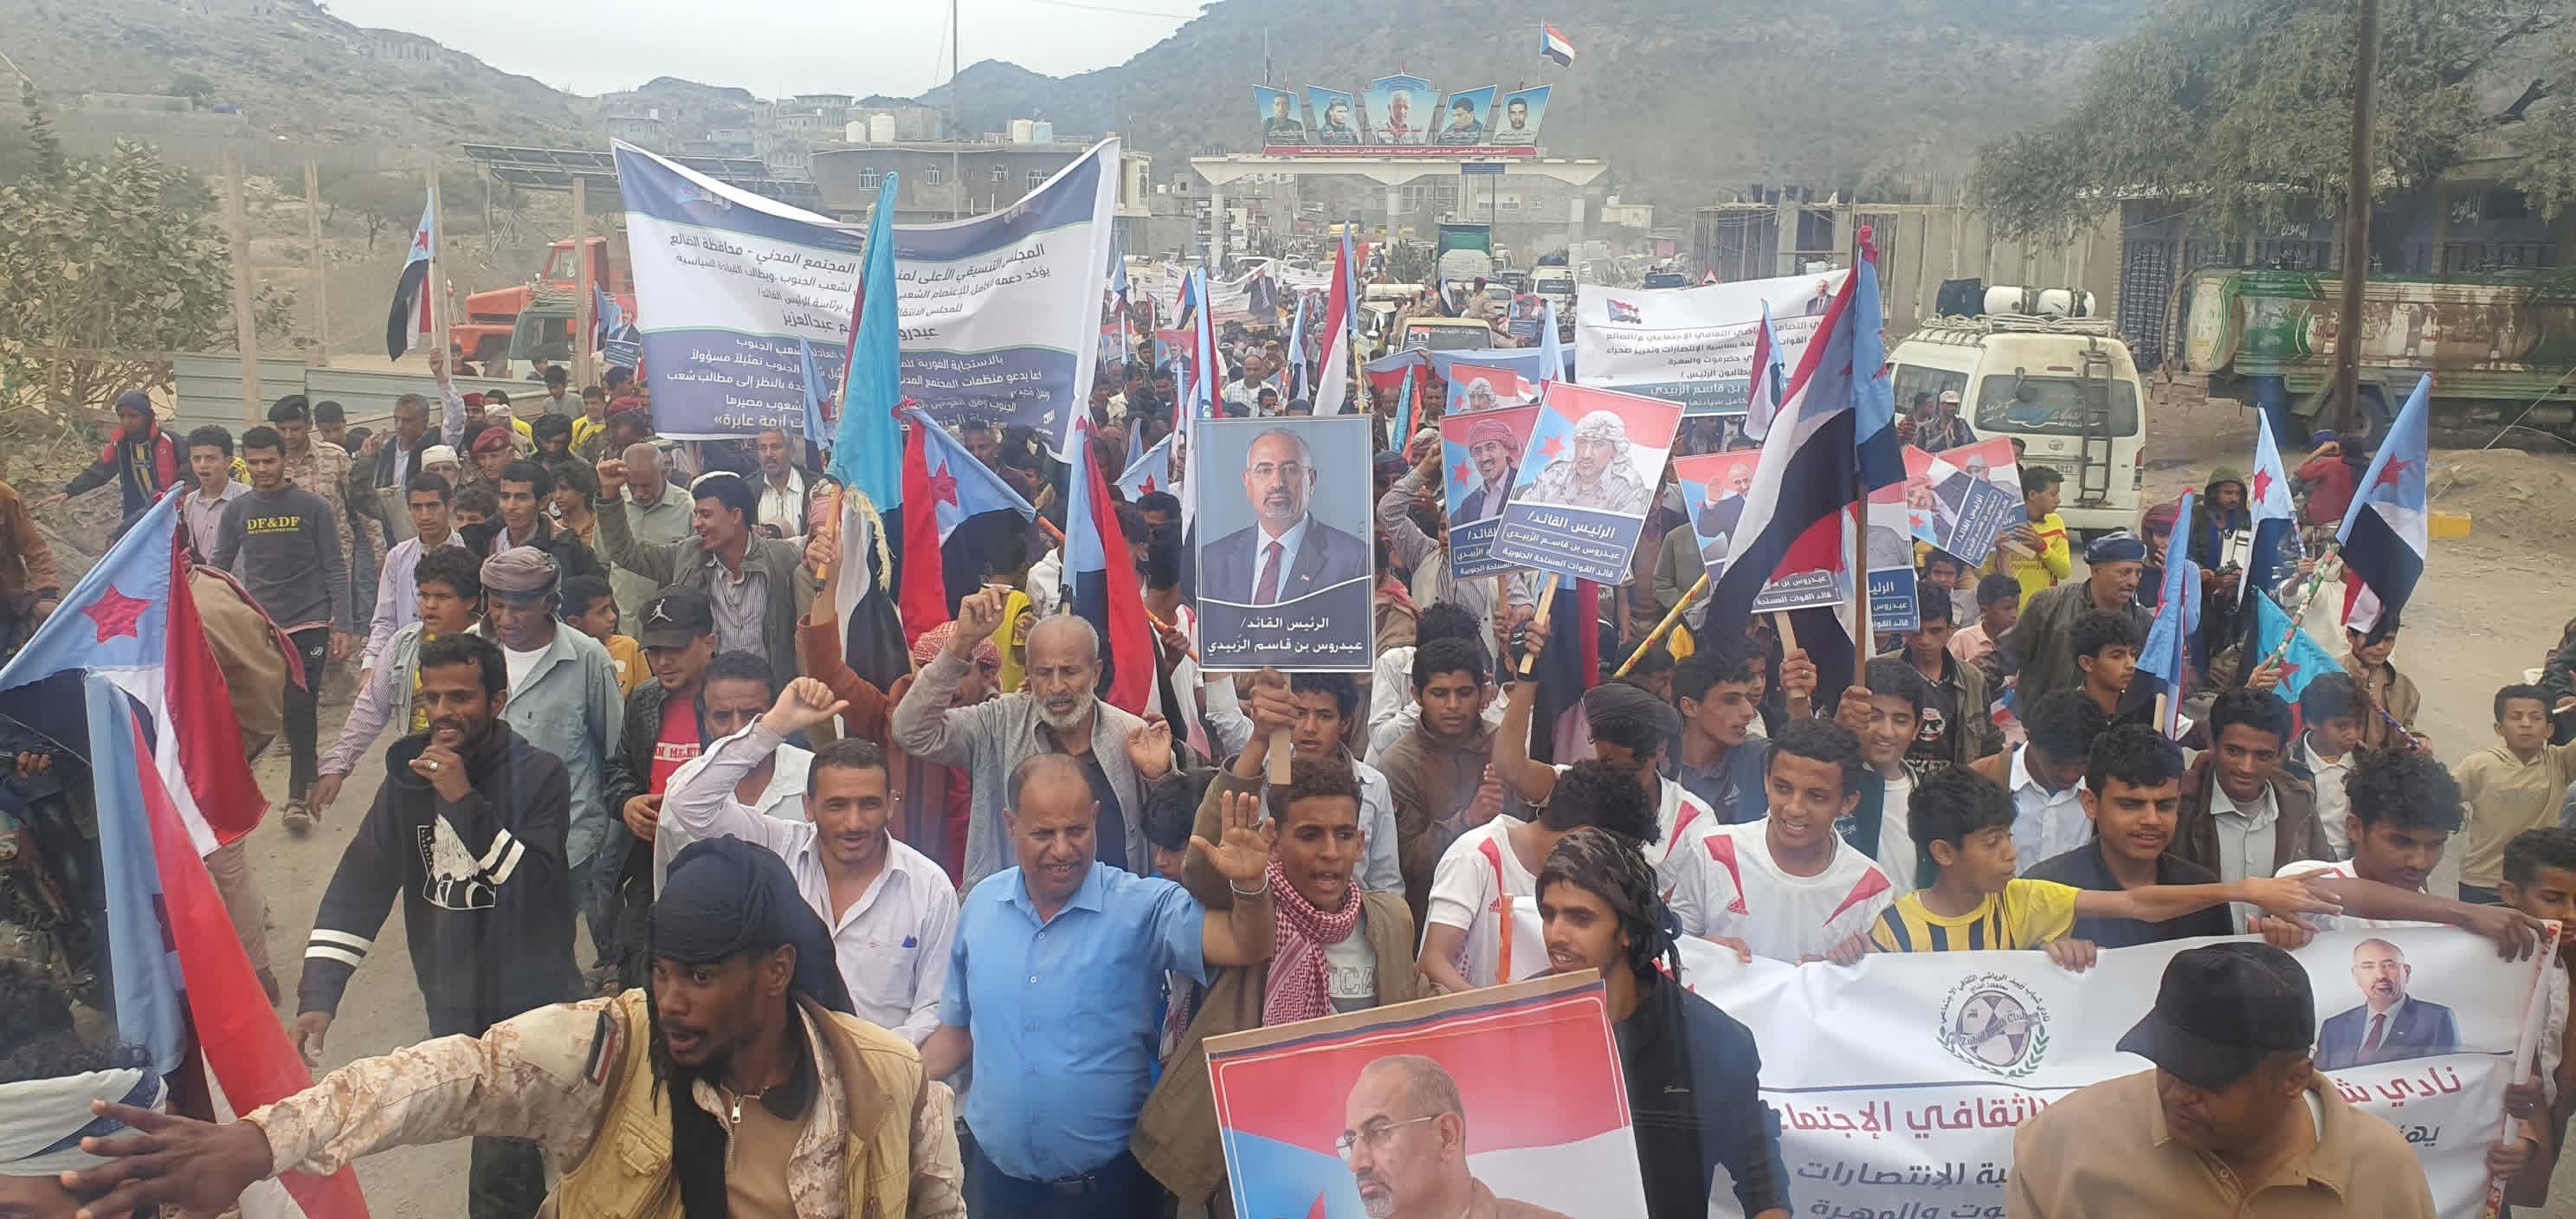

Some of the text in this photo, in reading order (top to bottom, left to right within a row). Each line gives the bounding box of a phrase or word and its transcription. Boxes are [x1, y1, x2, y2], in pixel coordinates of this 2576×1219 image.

[670, 232, 700, 248] الضالع
[702, 238, 743, 256] محافظة
[755, 248, 802, 265] المدني
[1003, 243, 1045, 268] المجلس
[717, 262, 743, 275] القيادة
[803, 257, 856, 275] المجتمع
[956, 257, 1003, 282] التنسيقي
[1025, 266, 1050, 280] يؤكد
[780, 276, 817, 288] الجنوب
[996, 274, 1023, 287] دعمه
[817, 281, 854, 294] لشعب
[784, 295, 812, 306] الرئيس
[898, 304, 926, 317] الانتقا
[926, 303, 964, 316] للمجلس
[782, 310, 835, 331] عبدالعزيز
[899, 326, 940, 341] عيدرو
[736, 338, 773, 352] الجنوب
[775, 345, 804, 356] شعب
[765, 359, 800, 374] الجنوب
[917, 358, 950, 371] الفورية
[667, 368, 695, 381] شعب
[698, 372, 733, 384] مطالب
[1006, 372, 1030, 384] يدعو
[1030, 370, 1043, 382] كما
[1687, 369, 1716, 379] الرئيس
[736, 375, 753, 389] إلى
[755, 375, 785, 390] بالنظر
[925, 377, 959, 389] المجتمع
[962, 374, 1004, 388] منظمات
[1692, 383, 1726, 395] قاسم
[726, 394, 763, 408] مصيرها
[765, 400, 804, 412] شعوب
[248, 516, 300, 530] DF&DF
[1468, 527, 1497, 540] لقائد/
[1570, 521, 1616, 539] الرئيس
[1540, 537, 1569, 550] قاسم
[1570, 542, 1581, 553] بن
[1582, 545, 1621, 560] عيدروس
[1502, 546, 1615, 578] قائد القوات المسلحة الجنوبية
[1792, 575, 1828, 586] عيدروس
[1869, 581, 1895, 596] الرئي
[1789, 592, 1816, 603] القوات
[1816, 591, 1832, 600] قائد
[1873, 602, 1908, 612] عيدروس
[1287, 616, 1329, 632] الرئيس
[1873, 619, 1909, 629] قائد القوا
[1254, 638, 1291, 654] قاسم
[1294, 641, 1309, 654] بن
[1312, 641, 1364, 655] عيدروس
[2376, 1066, 2461, 1108] نادي
[1782, 1100, 1892, 1140] الإجتما
